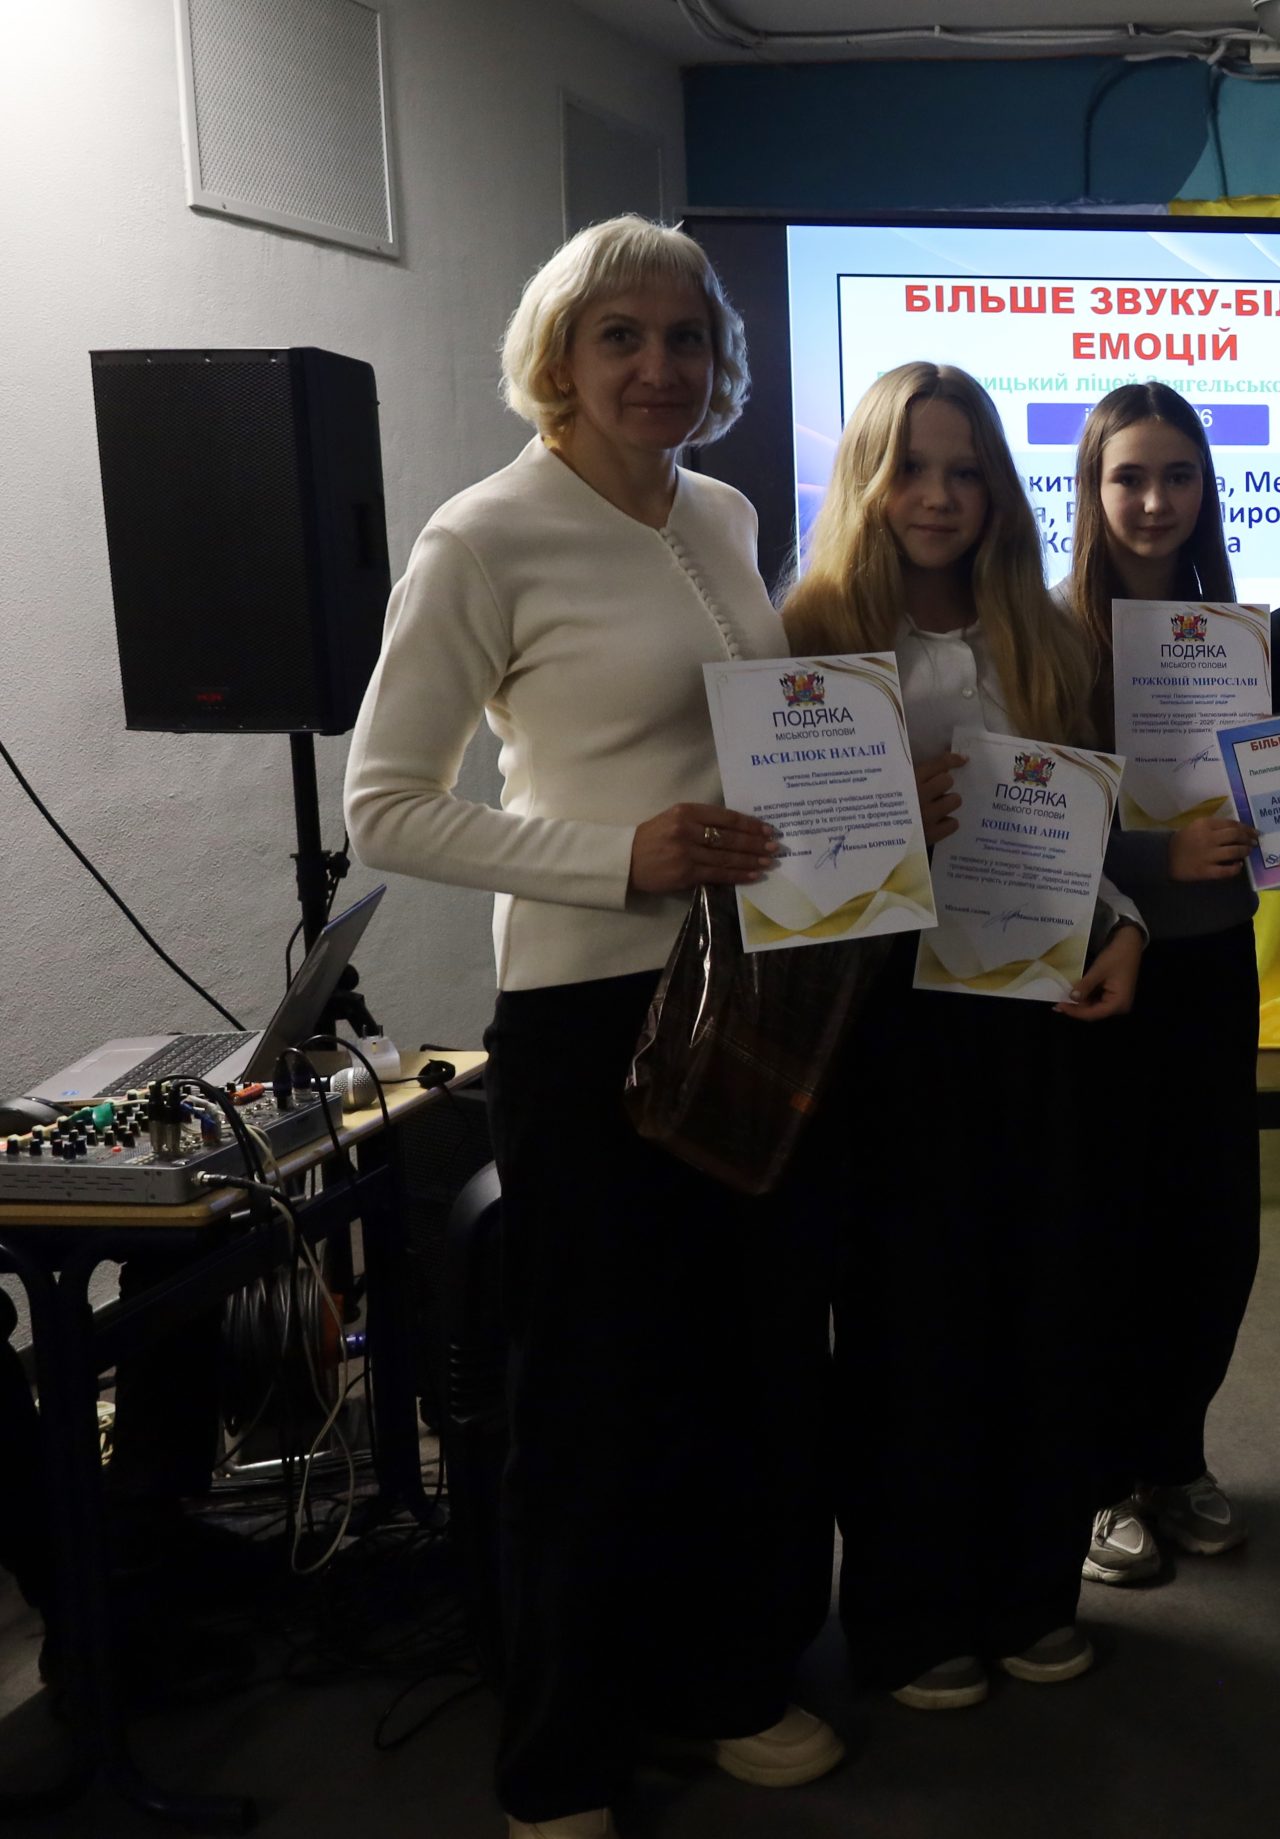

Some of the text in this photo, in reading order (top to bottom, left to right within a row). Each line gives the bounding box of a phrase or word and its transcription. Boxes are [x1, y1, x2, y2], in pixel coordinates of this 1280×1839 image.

[905, 285, 1075, 315] БІЛЬШЕ
[1072, 327, 1238, 366] ЕМОЦІЙ
[1160, 643, 1226, 660] ПОДЯКА
[1198, 661, 1226, 669] ГОЛОВИ
[1131, 674, 1257, 686] РОЖКОВІЙ МИРОСЛАВІ
[772, 706, 853, 730] ПОДЯКА
[775, 727, 855, 741] МІСЬКОГО ГОЛОВИ
[750, 741, 886, 766] ВАСИЛЮК НАТАЛІЇ
[994, 783, 1068, 810] ПОДЯКА
[991, 802, 1065, 820] МІСЬКОГО ГОЛОВИ
[980, 818, 1070, 840] КОШМАН АННІ
